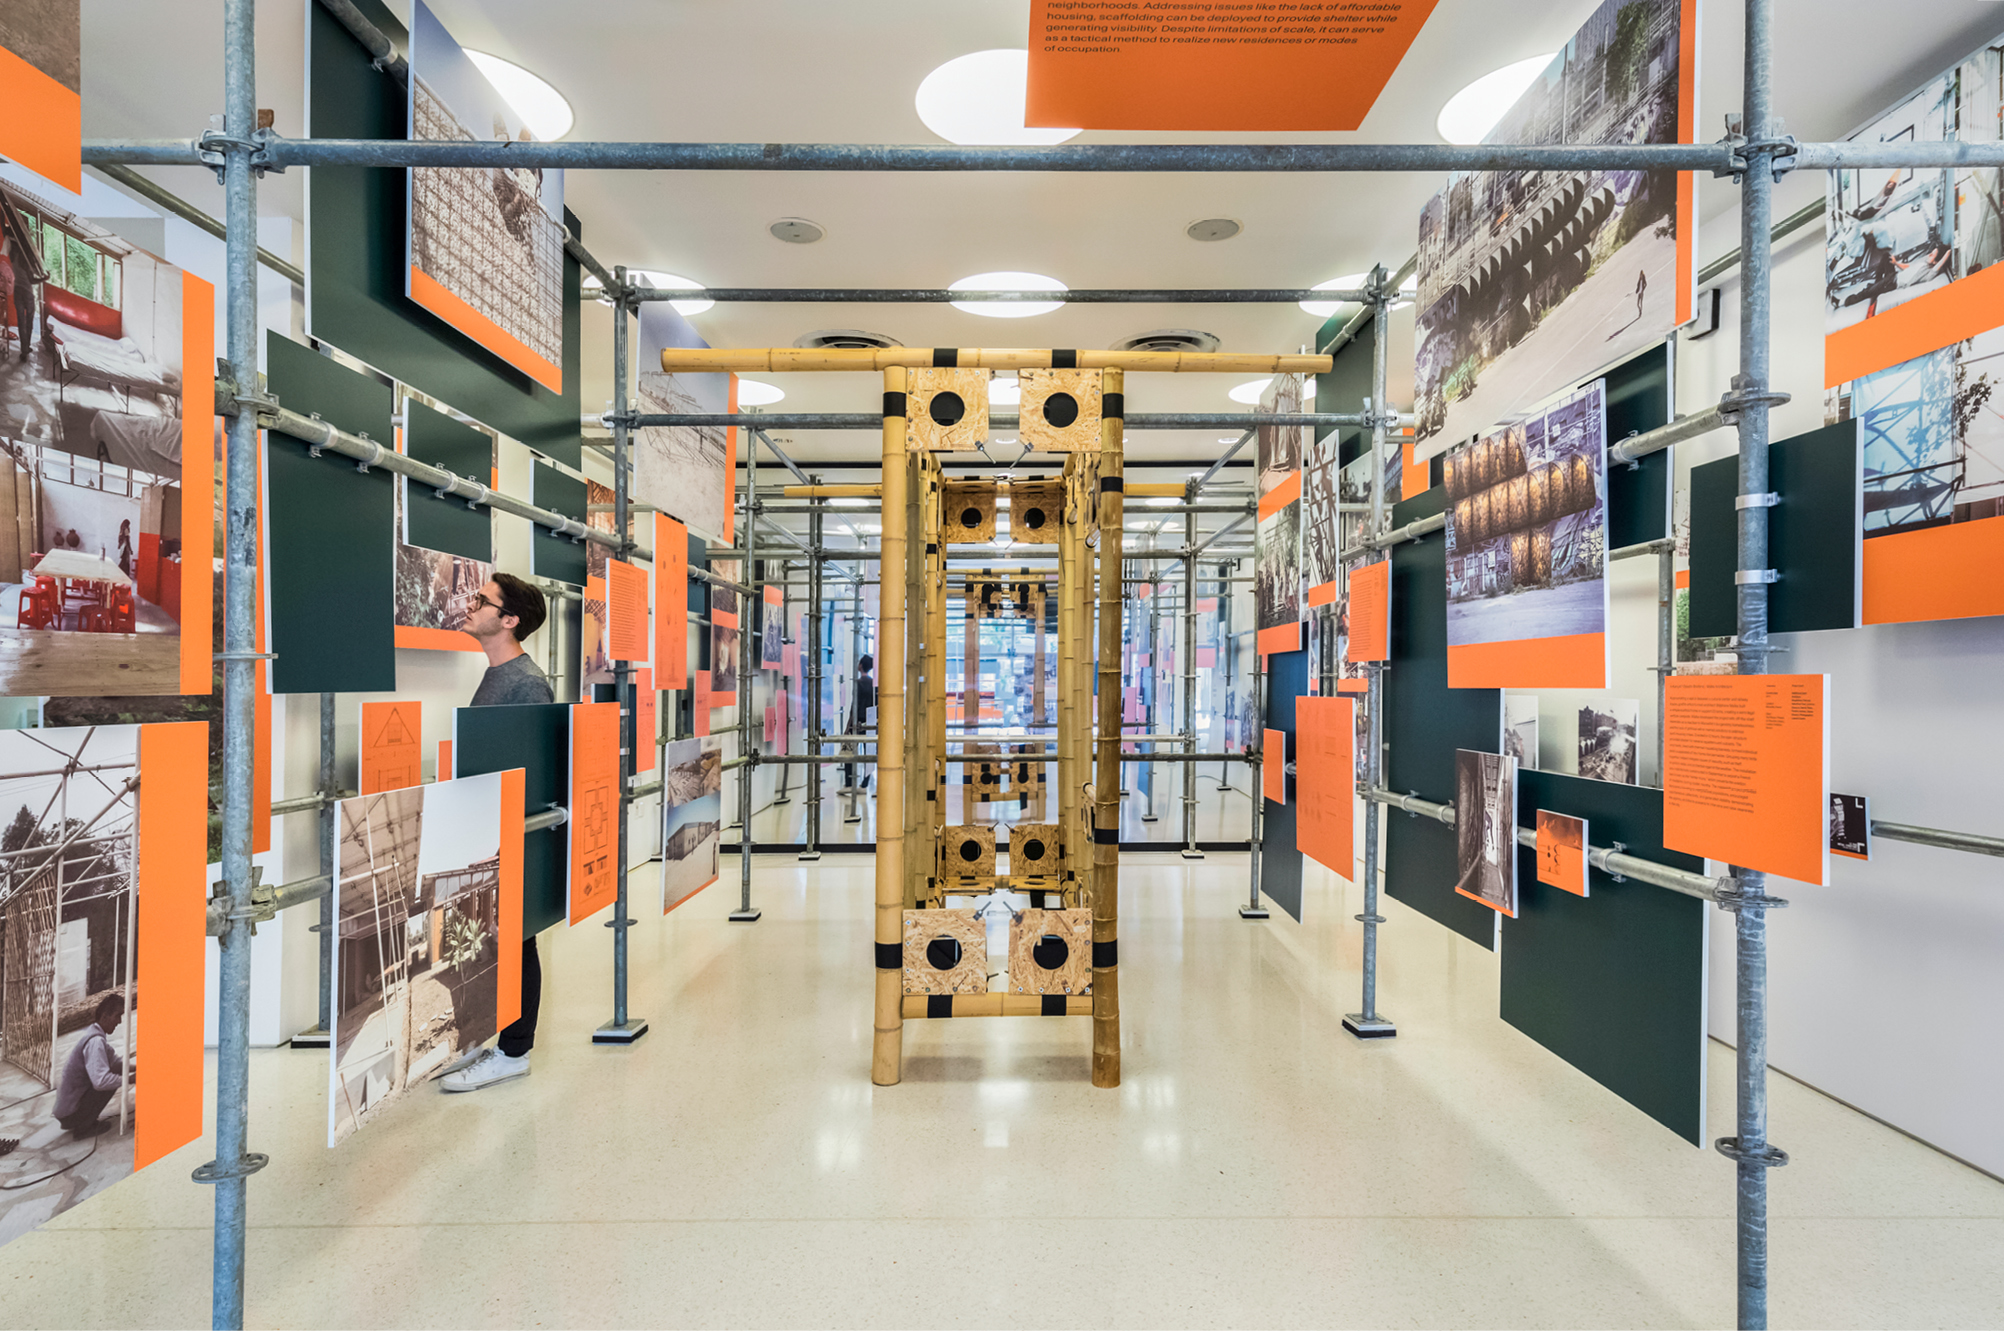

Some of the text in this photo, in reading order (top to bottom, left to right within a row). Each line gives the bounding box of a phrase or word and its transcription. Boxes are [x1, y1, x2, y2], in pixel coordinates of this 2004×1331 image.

[1048, 1, 1140, 10] neighborhoods.
[1143, 2, 1212, 11] Addressing
[1340, 3, 1402, 11] affordable
[1047, 13, 1097, 21] housing,
[1099, 14, 1164, 22] scaffolding
[1207, 14, 1262, 23] deployed
[1276, 14, 1321, 23] provide
[1046, 24, 1108, 32] generating
[1161, 25, 1206, 34] Despite
[1283, 26, 1316, 34] scale,
